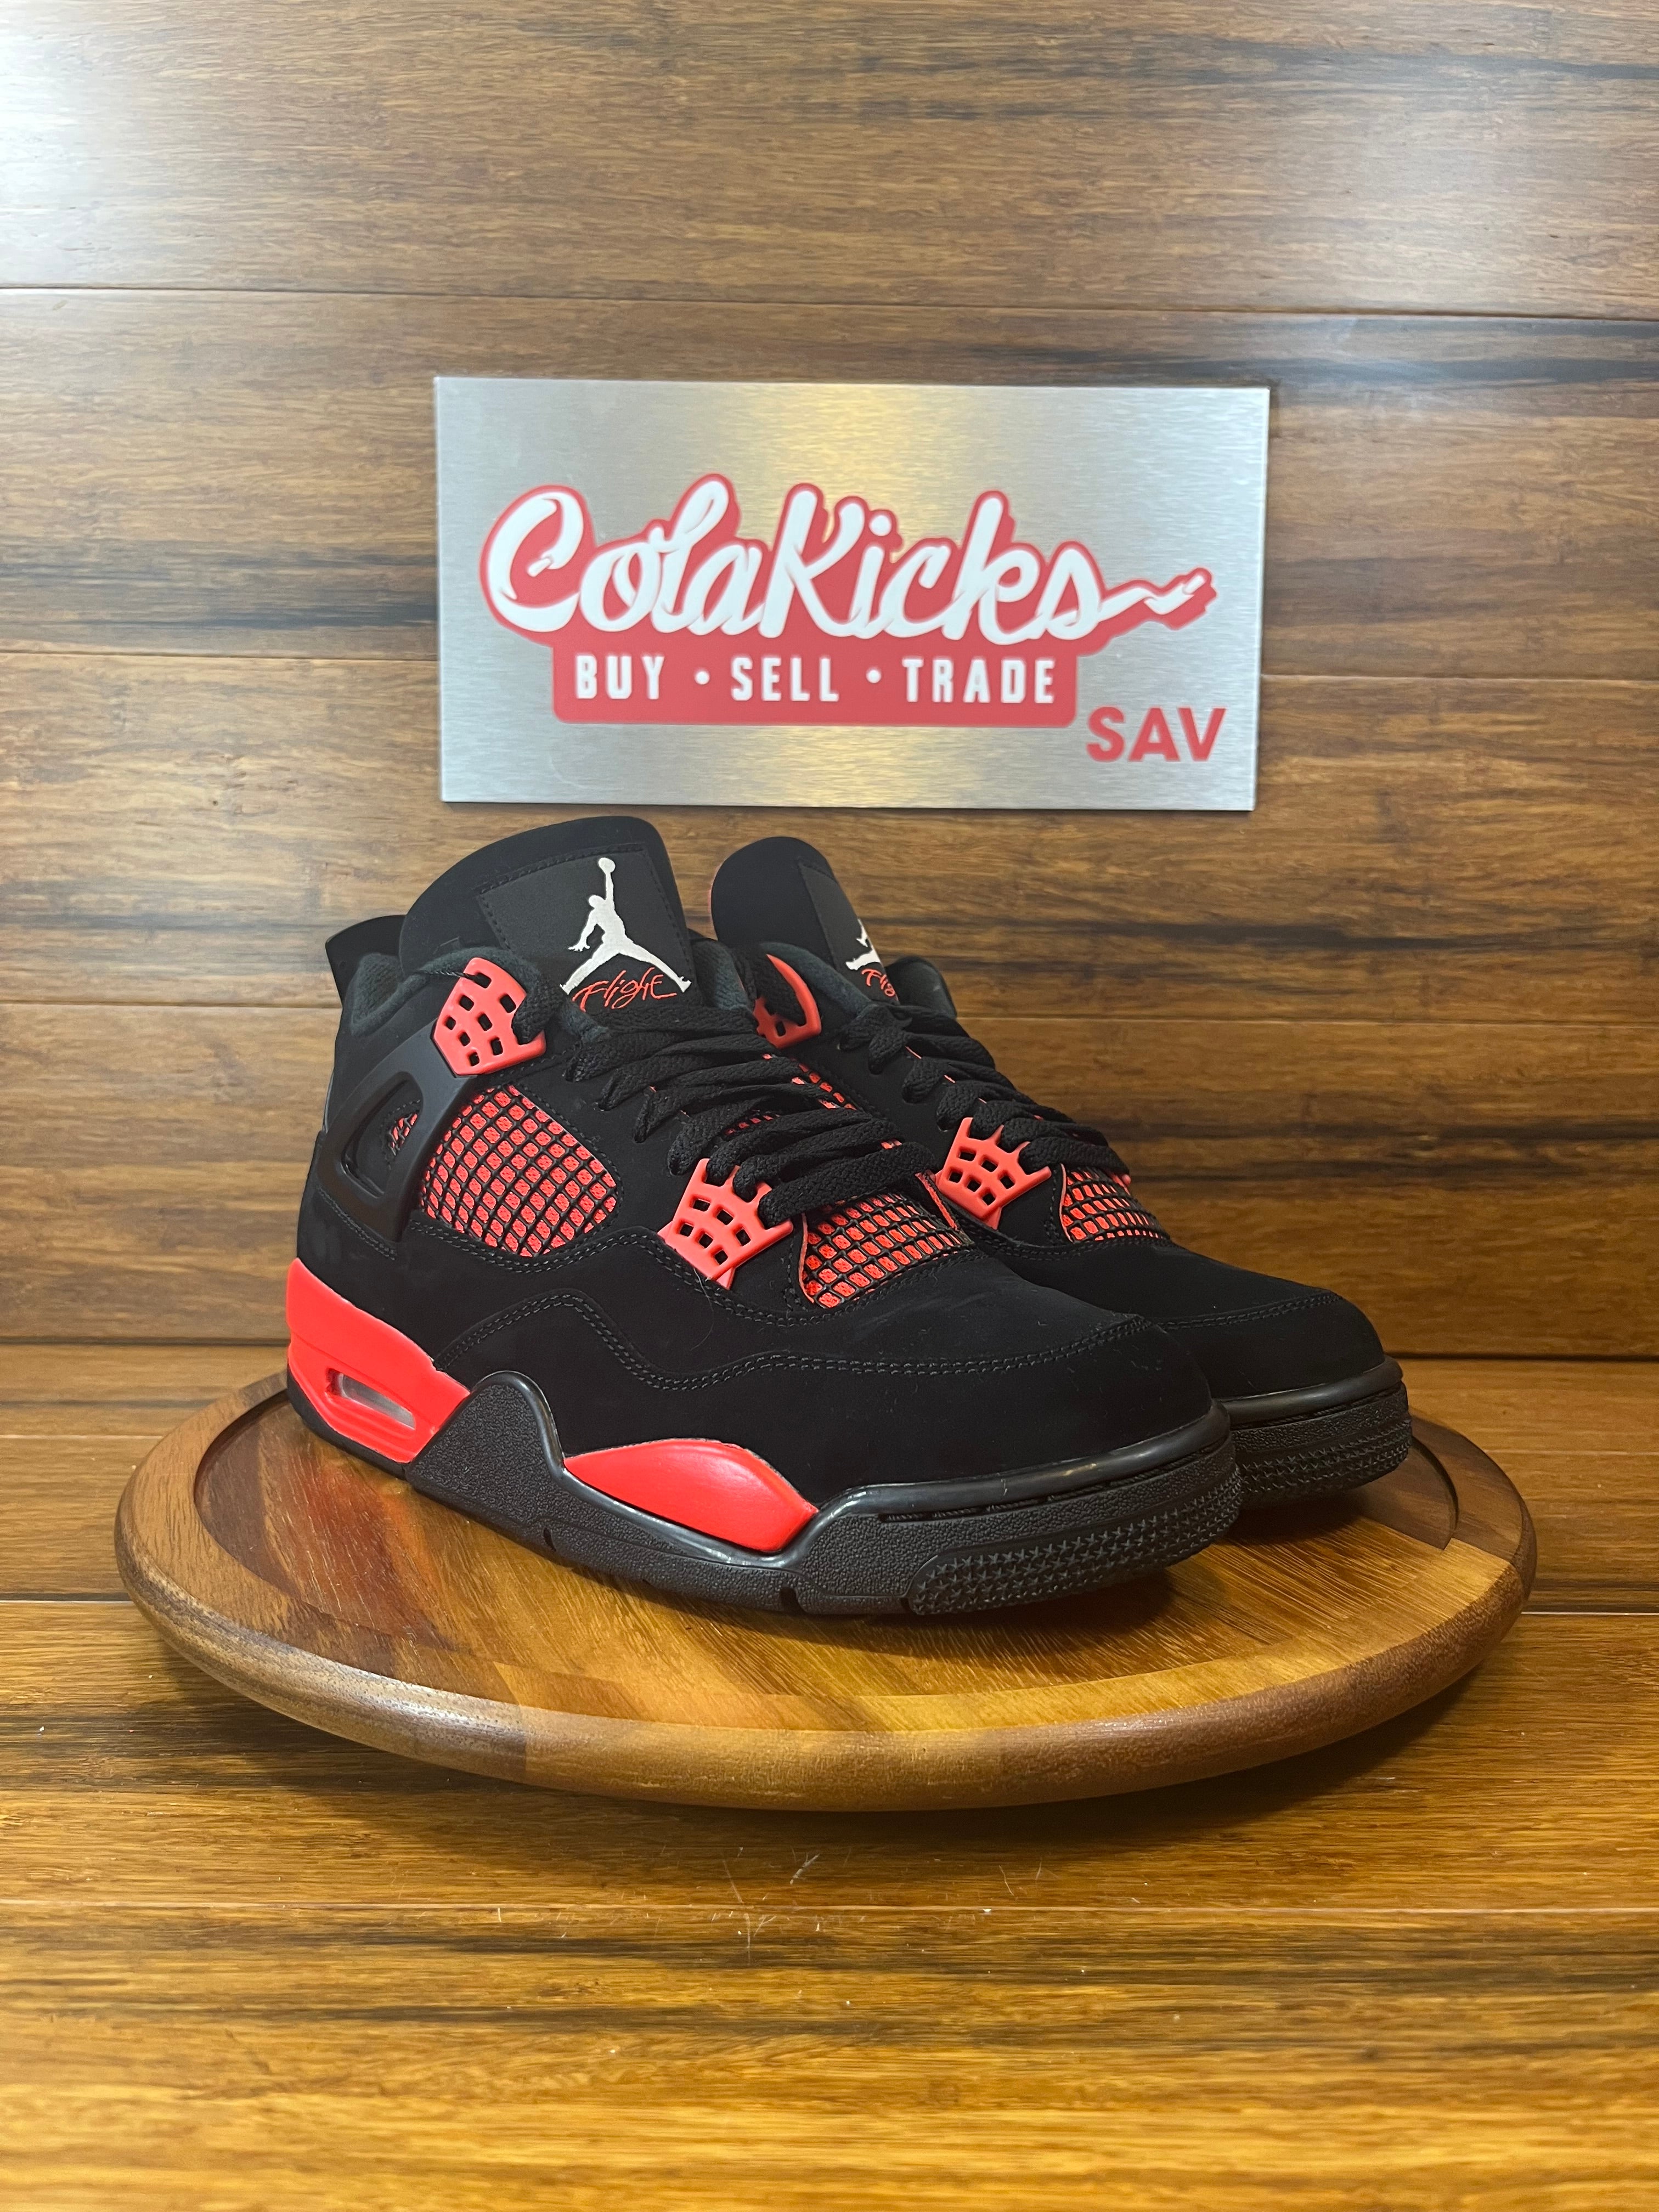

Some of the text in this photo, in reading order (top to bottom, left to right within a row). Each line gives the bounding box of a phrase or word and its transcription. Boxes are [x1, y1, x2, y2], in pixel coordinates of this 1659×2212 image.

[488, 479, 1205, 645] ColaKicks
[575, 654, 1055, 704] BUY SELL TRADE
[1086, 706, 1227, 762] SAV
[572, 967, 677, 1012] Flight
